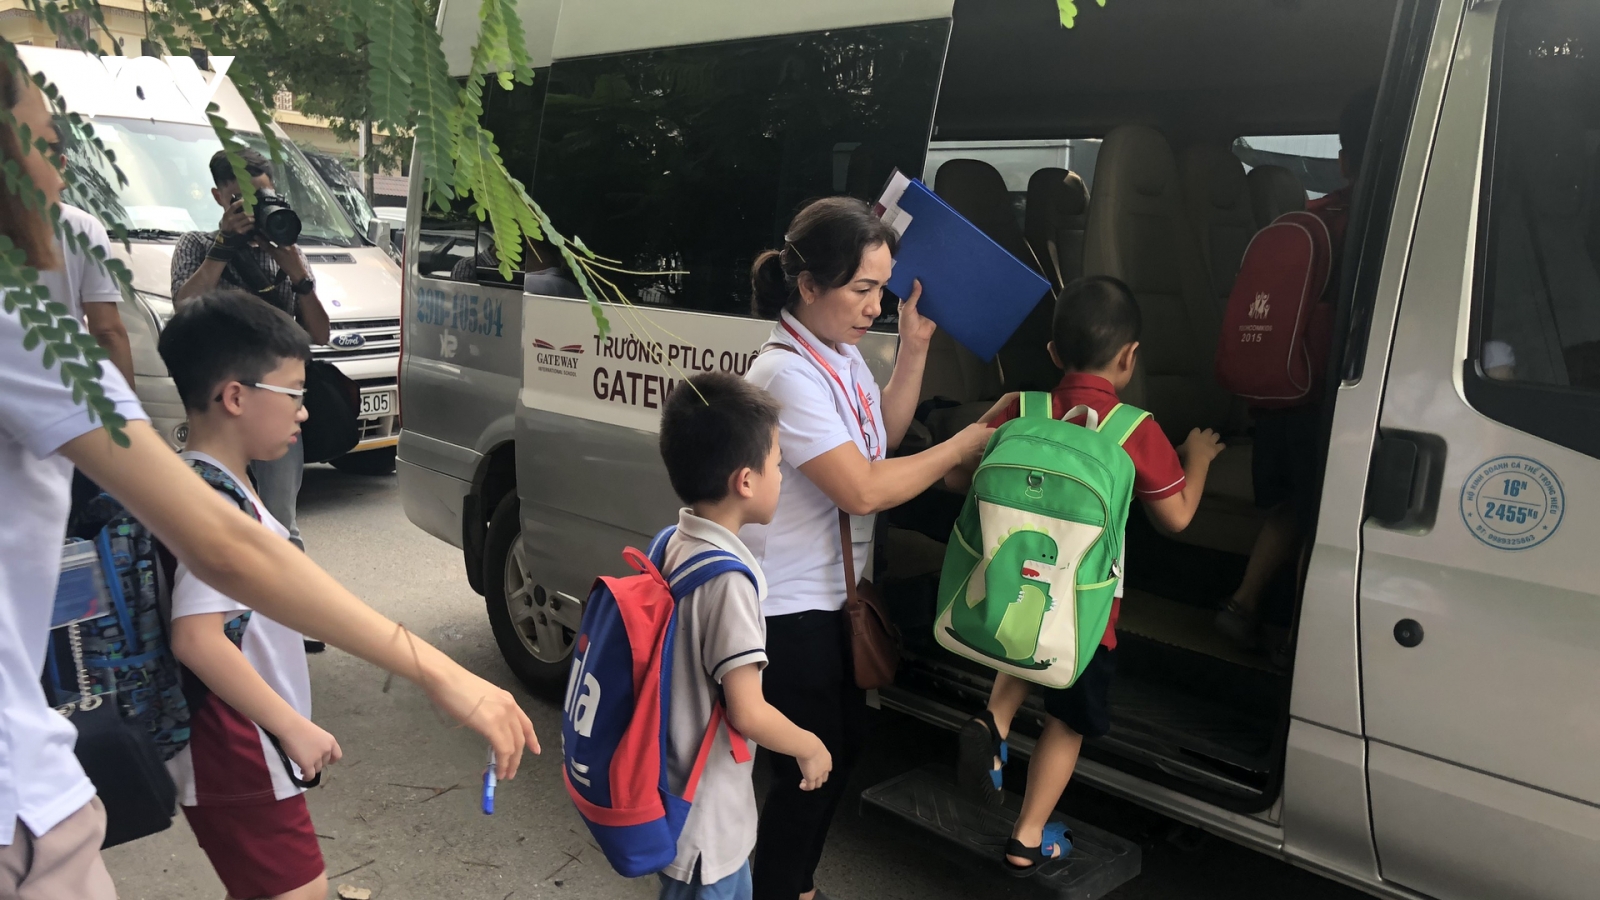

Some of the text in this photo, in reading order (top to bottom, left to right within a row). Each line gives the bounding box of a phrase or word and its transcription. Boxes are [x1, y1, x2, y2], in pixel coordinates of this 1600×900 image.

[338, 334, 359, 346] Ford
[1241, 333, 1262, 343] 2015
[593, 333, 662, 365] TRƯỜNG
[667, 344, 714, 372] PTLC
[536, 352, 579, 369] GATEWAY
[563, 370, 577, 378] SCHOOL
[1471, 474, 1484, 490] KINH
[1483, 462, 1509, 476] DOANH
[1511, 460, 1521, 469] CÁ
